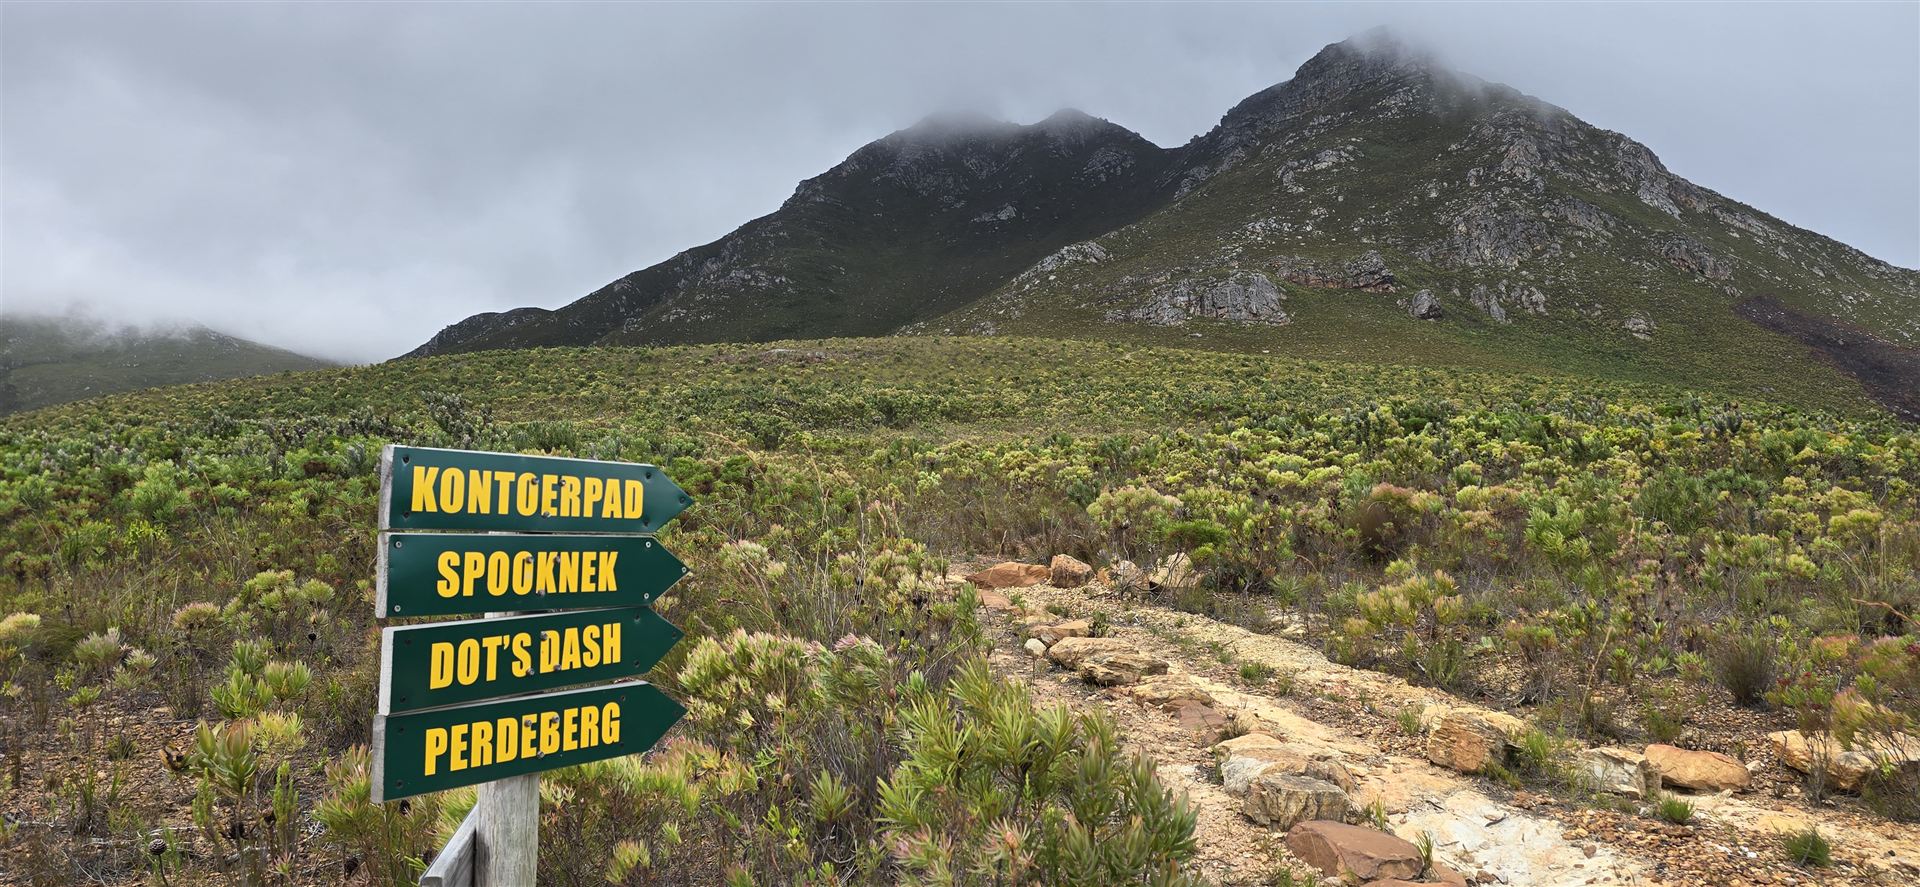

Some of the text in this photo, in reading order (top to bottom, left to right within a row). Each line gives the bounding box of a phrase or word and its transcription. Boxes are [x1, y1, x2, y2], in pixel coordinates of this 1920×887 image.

[410, 466, 645, 519] KONTOERPAD
[436, 550, 618, 598] SPOOKNEK
[429, 622, 622, 690] DOT'S DASH
[424, 701, 622, 777] PERDEBERG
